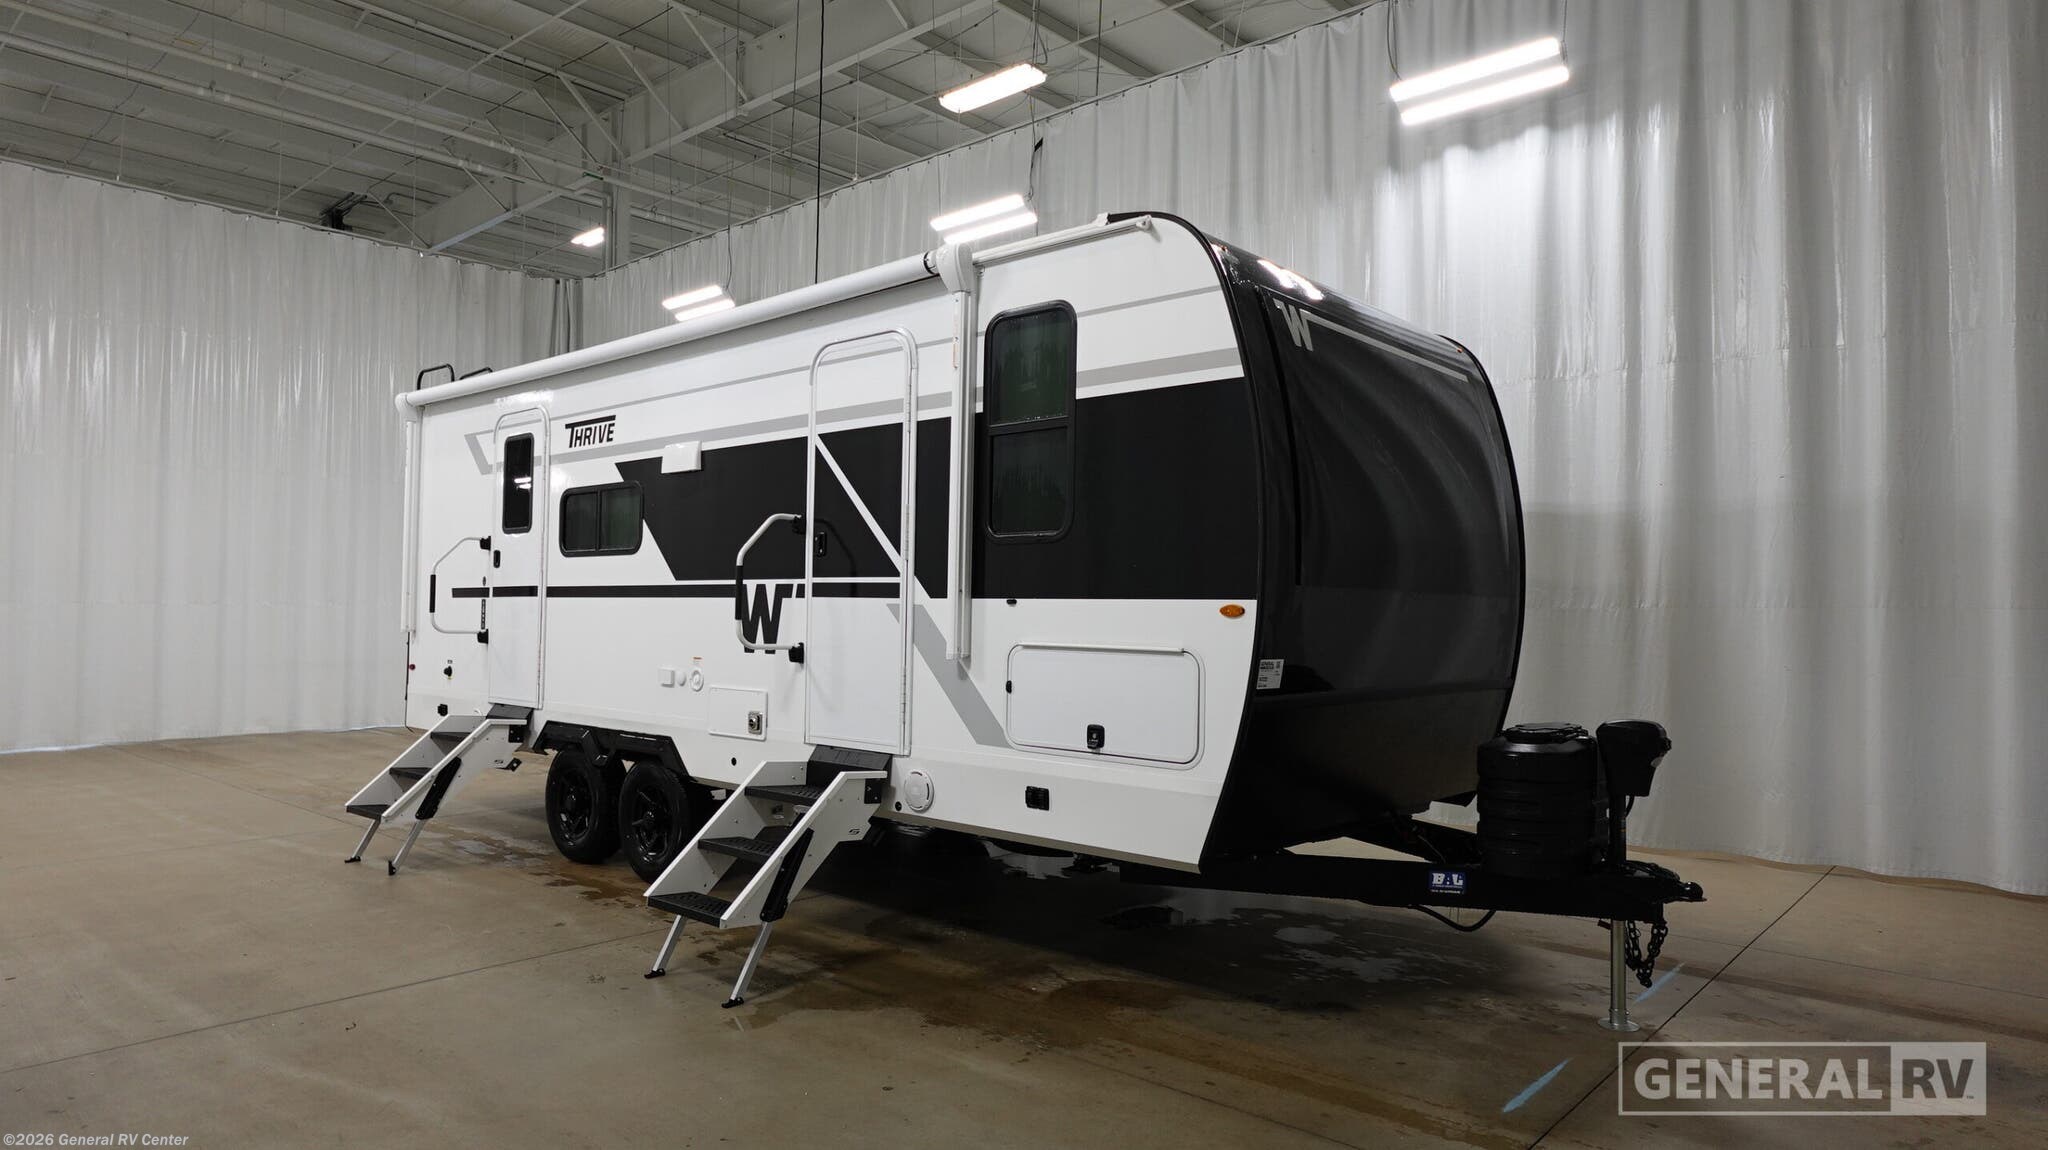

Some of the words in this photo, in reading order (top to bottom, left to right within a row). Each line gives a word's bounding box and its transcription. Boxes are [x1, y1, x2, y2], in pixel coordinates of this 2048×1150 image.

[1272, 297, 1314, 352] W
[565, 414, 616, 448] THRIVE
[737, 583, 794, 654] W
